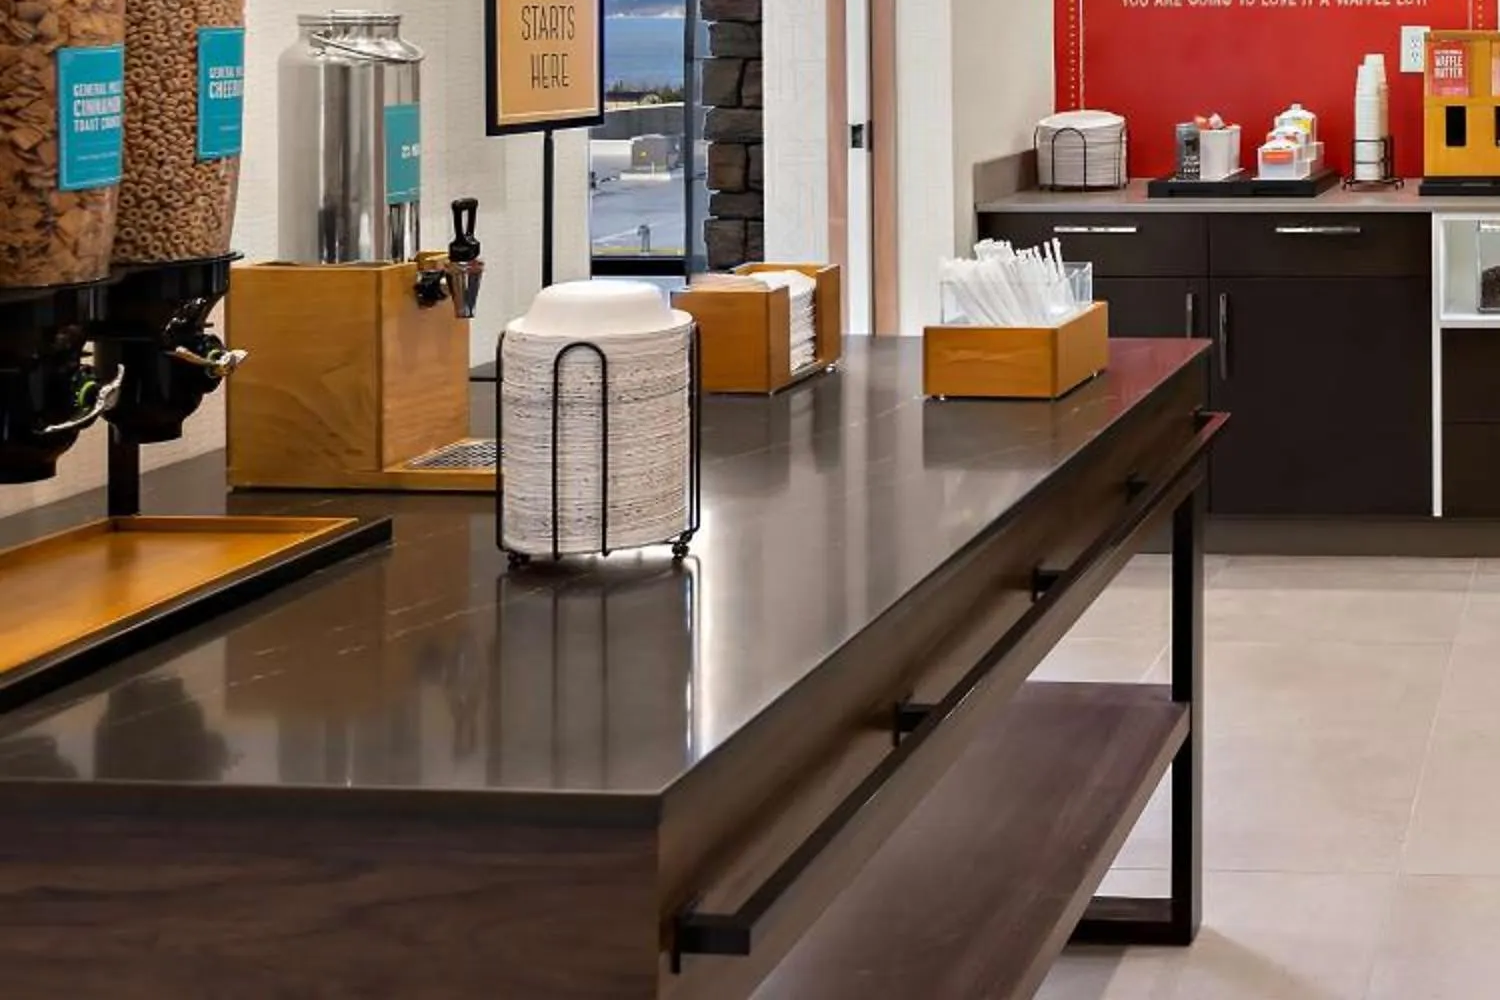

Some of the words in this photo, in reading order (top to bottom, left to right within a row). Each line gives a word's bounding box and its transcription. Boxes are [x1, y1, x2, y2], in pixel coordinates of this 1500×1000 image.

[520, 4, 576, 41] STARTS
[530, 52, 571, 90] HERE
[1433, 55, 1463, 67] WAFFLE
